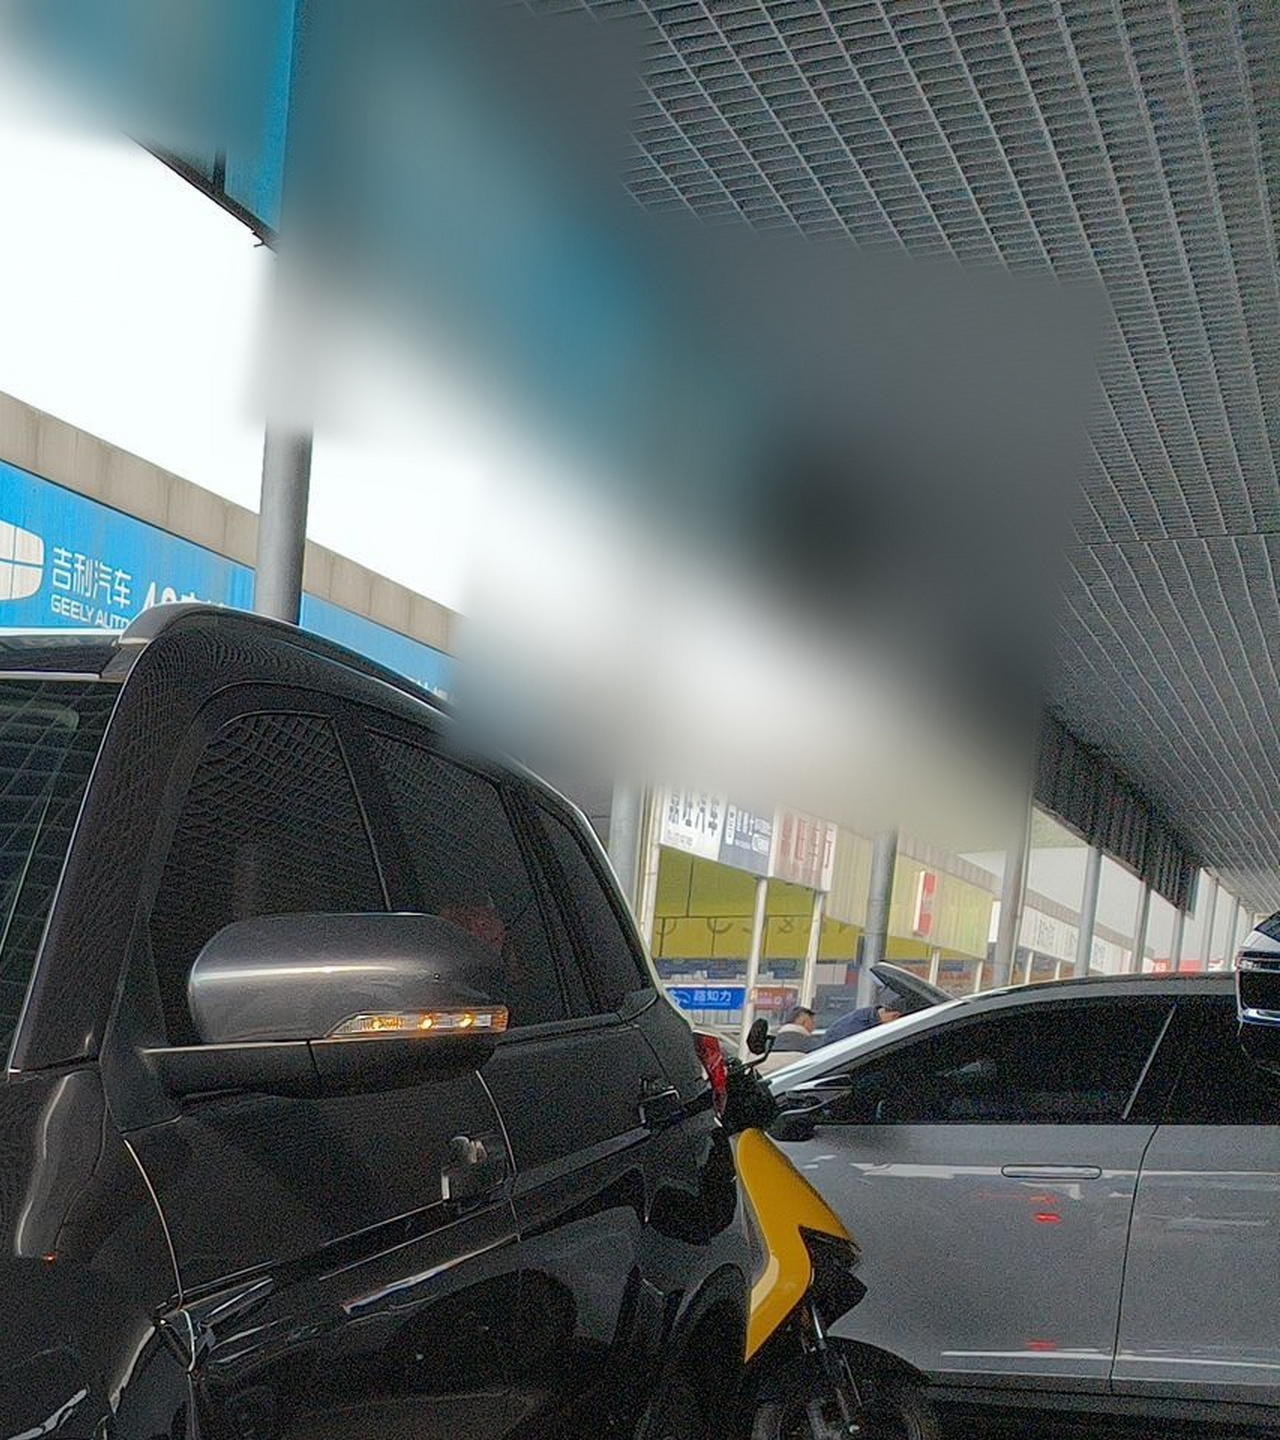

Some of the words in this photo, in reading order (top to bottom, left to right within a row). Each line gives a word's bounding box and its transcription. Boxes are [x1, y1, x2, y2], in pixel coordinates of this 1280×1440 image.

[53, 547, 132, 609] 吉利汽车
[51, 593, 95, 622] GEELY
